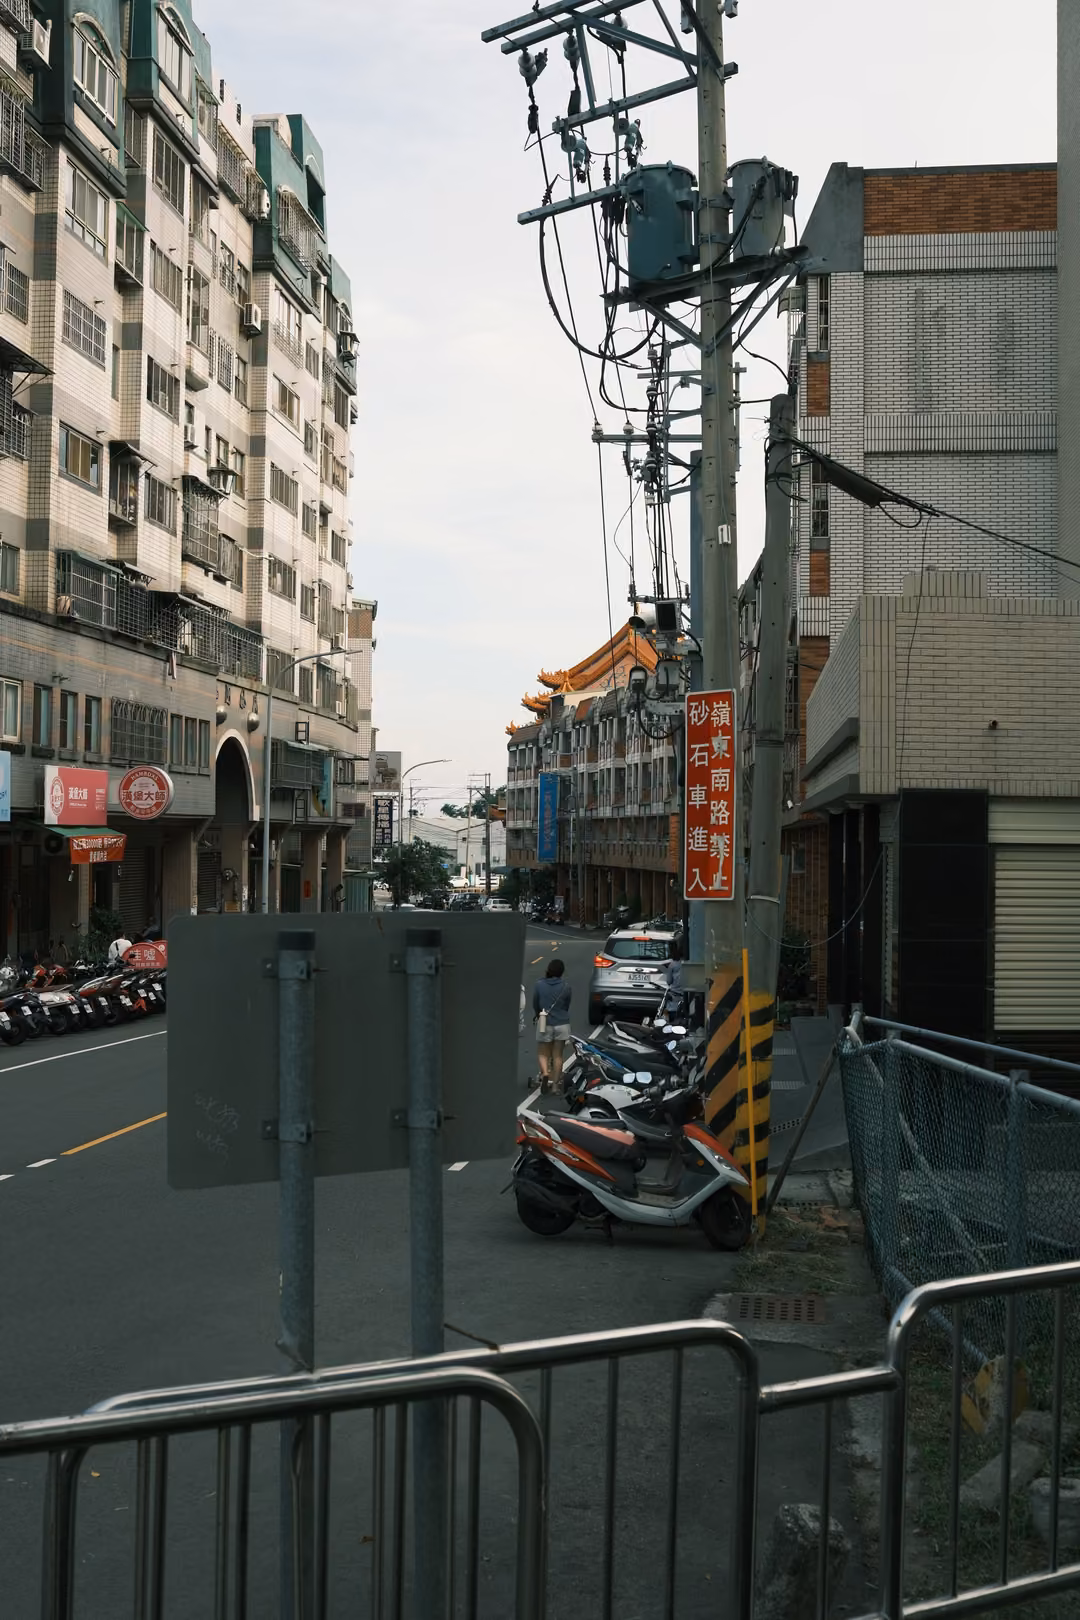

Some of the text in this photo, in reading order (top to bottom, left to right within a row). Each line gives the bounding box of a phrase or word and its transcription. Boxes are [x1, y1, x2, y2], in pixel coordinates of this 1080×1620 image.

[121, 790, 166, 801] 漢堡大師
[687, 700, 710, 892] 砂石車進入
[708, 700, 731, 891] 嶺東南路禁止
